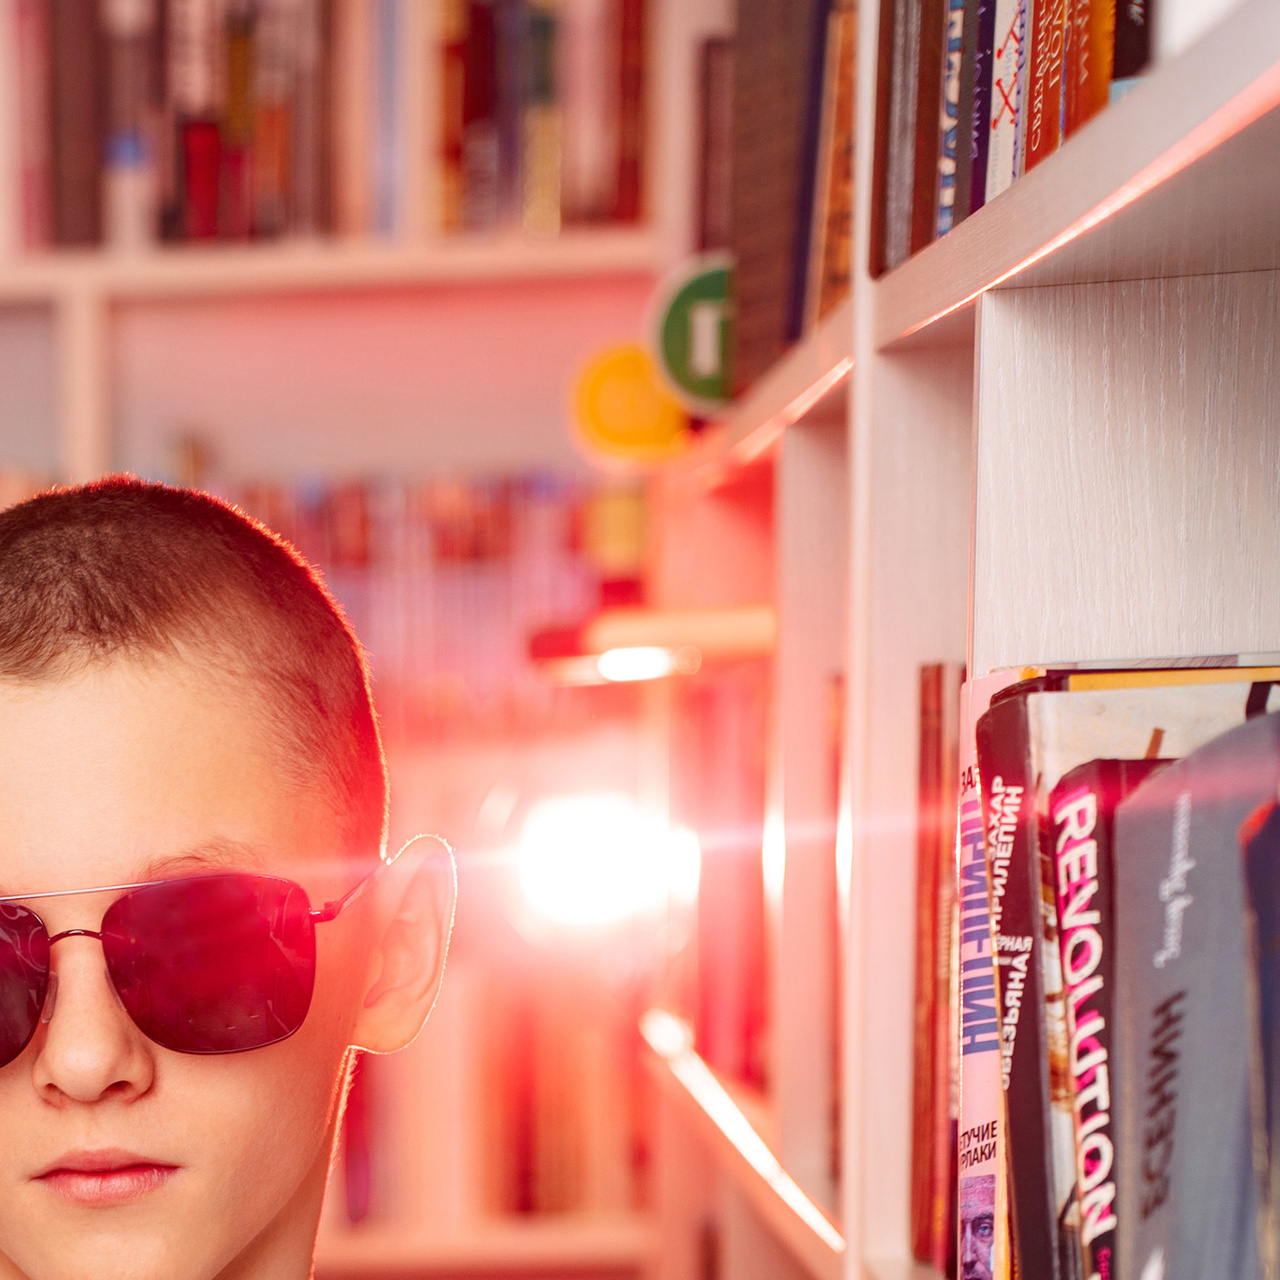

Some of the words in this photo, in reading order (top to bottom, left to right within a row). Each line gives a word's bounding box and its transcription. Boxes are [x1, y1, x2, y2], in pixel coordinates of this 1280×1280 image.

[988, 775, 1006, 863] ЗАХАР
[992, 786, 1024, 933] ПРИЛЕПИН
[1002, 953, 1030, 1091] ОБЕЗЬЯНА
[1054, 788, 1118, 1248] REVOLUTION
